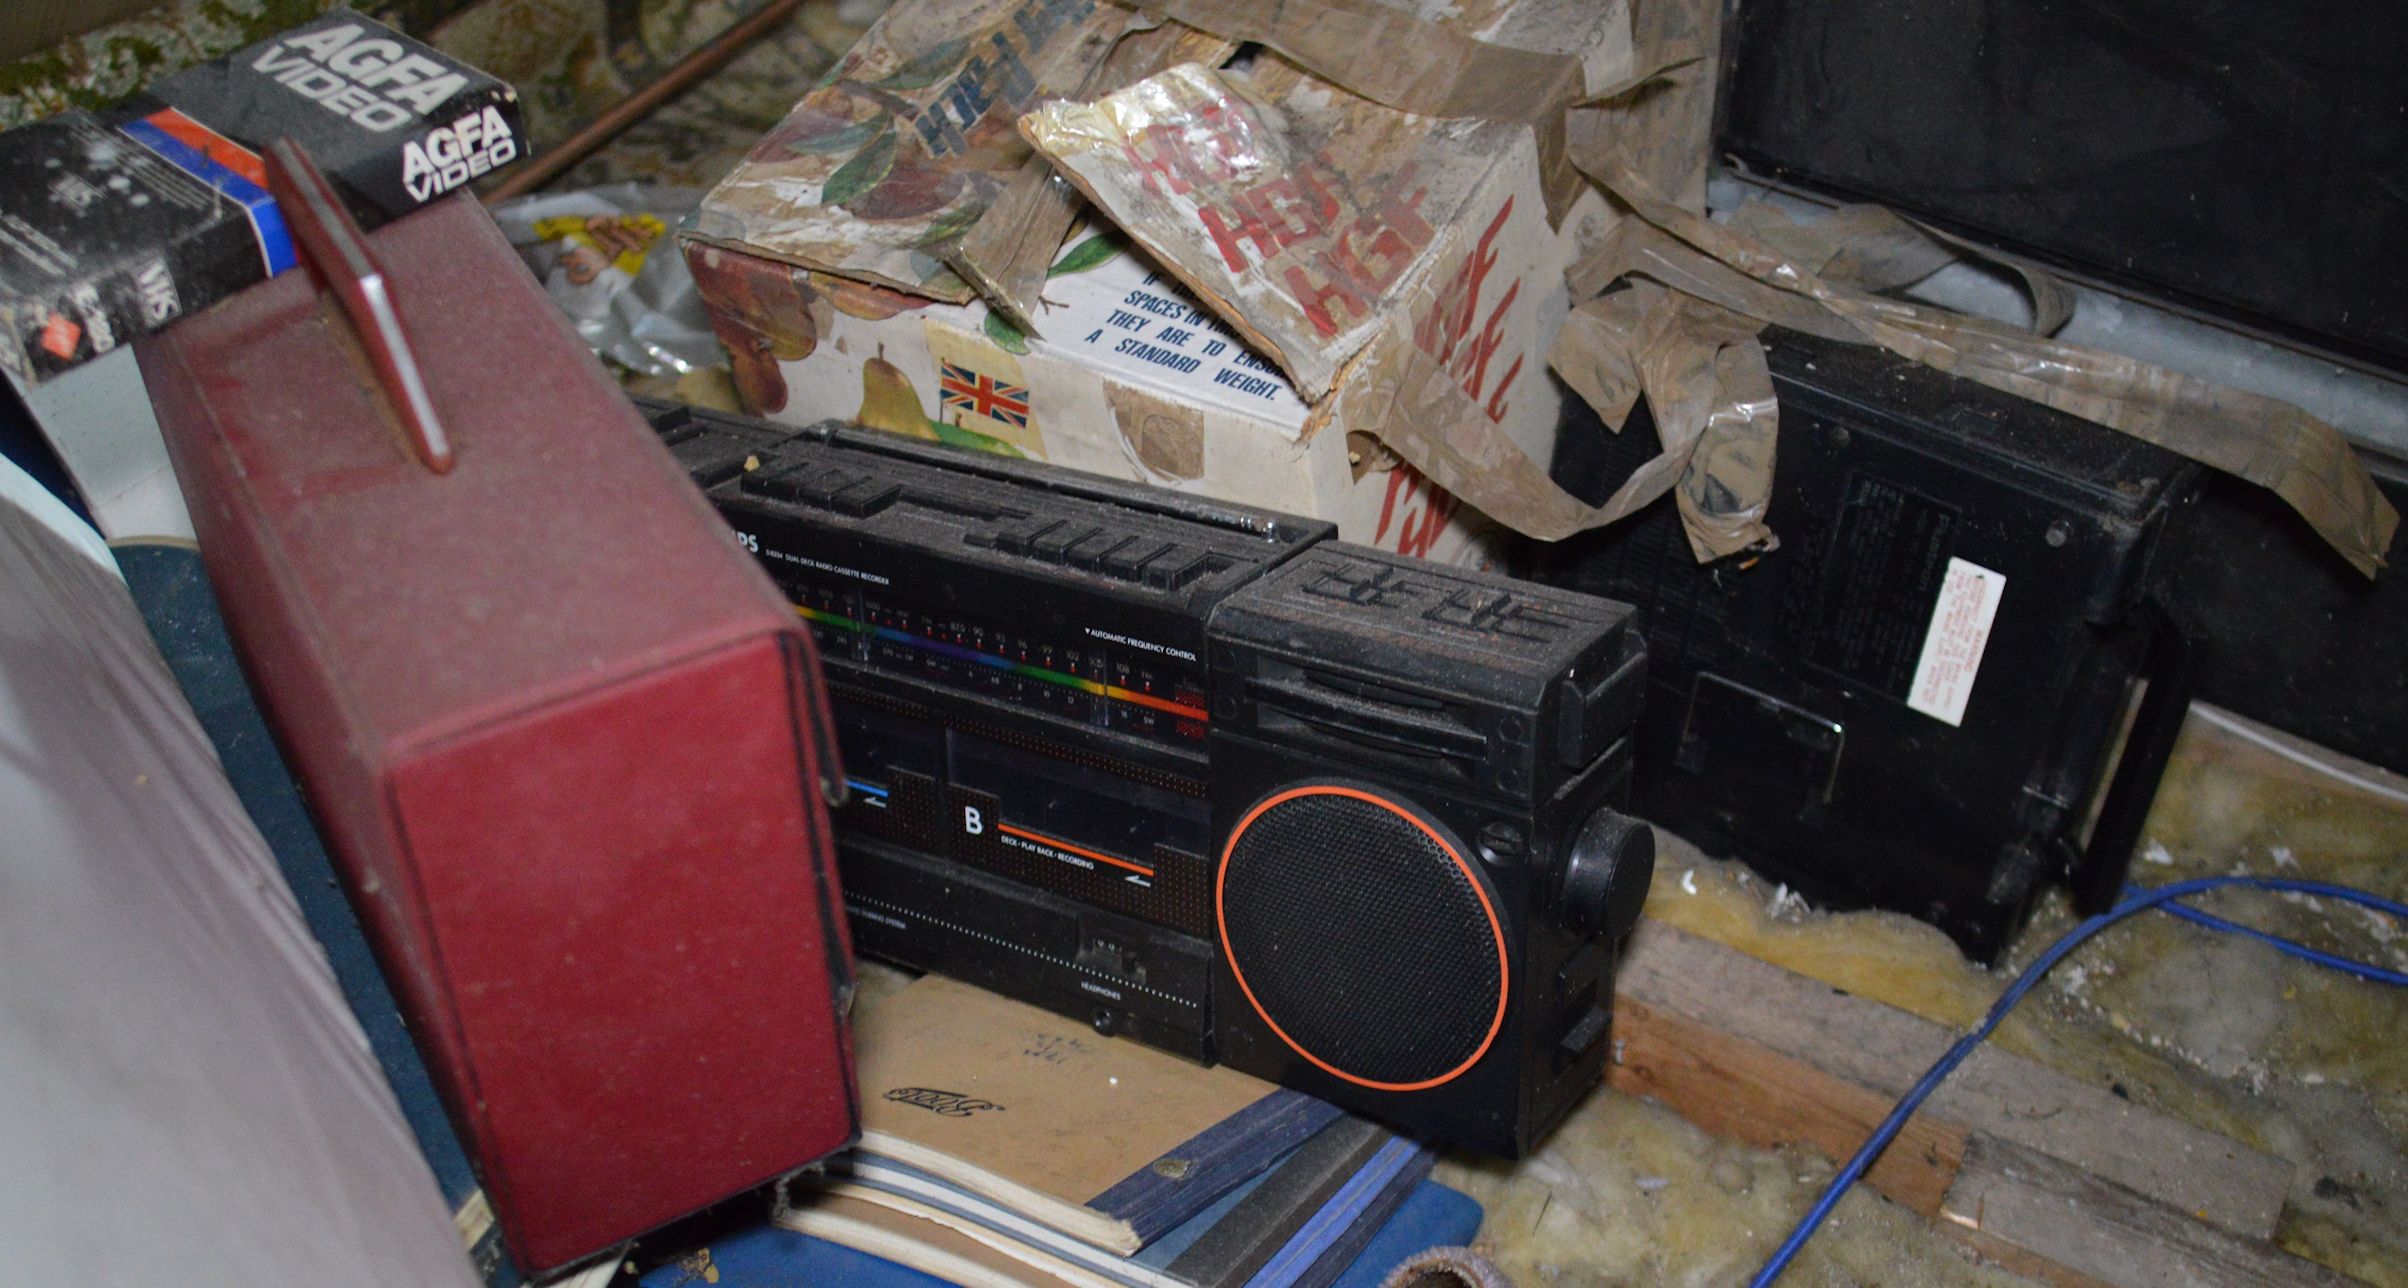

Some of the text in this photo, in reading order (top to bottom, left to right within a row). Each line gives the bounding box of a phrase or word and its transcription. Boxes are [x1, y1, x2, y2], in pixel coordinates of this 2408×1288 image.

[284, 24, 469, 115] AGFA
[252, 45, 412, 132] VIDEO
[402, 106, 512, 184] AGFA
[407, 136, 517, 202] VIDEO
[139, 260, 178, 329] VHS
[1142, 270, 1161, 286] IF
[1124, 290, 1188, 320] SPACES
[1183, 306, 1207, 327] IN
[1106, 309, 1151, 333] THEY
[1156, 326, 1195, 347] ARE
[1202, 339, 1227, 357] TO
[1084, 328, 1283, 401] A STANDARD WEIGHT.
[733, 531, 759, 552] PS
[785, 554, 799, 563] DUAL
[800, 557, 815, 567] DECK
[815, 560, 833, 571] RADIO
[833, 565, 860, 579] CASSETTE
[860, 571, 890, 585] RECORDER
[1091, 628, 1197, 662] AUTOMATIC FREQUENCY CONTROL
[964, 805, 983, 835] B
[1001, 834, 1095, 870] DECK PLAY BACK RECORDING
[1081, 981, 1121, 1000] HEADPHONES
